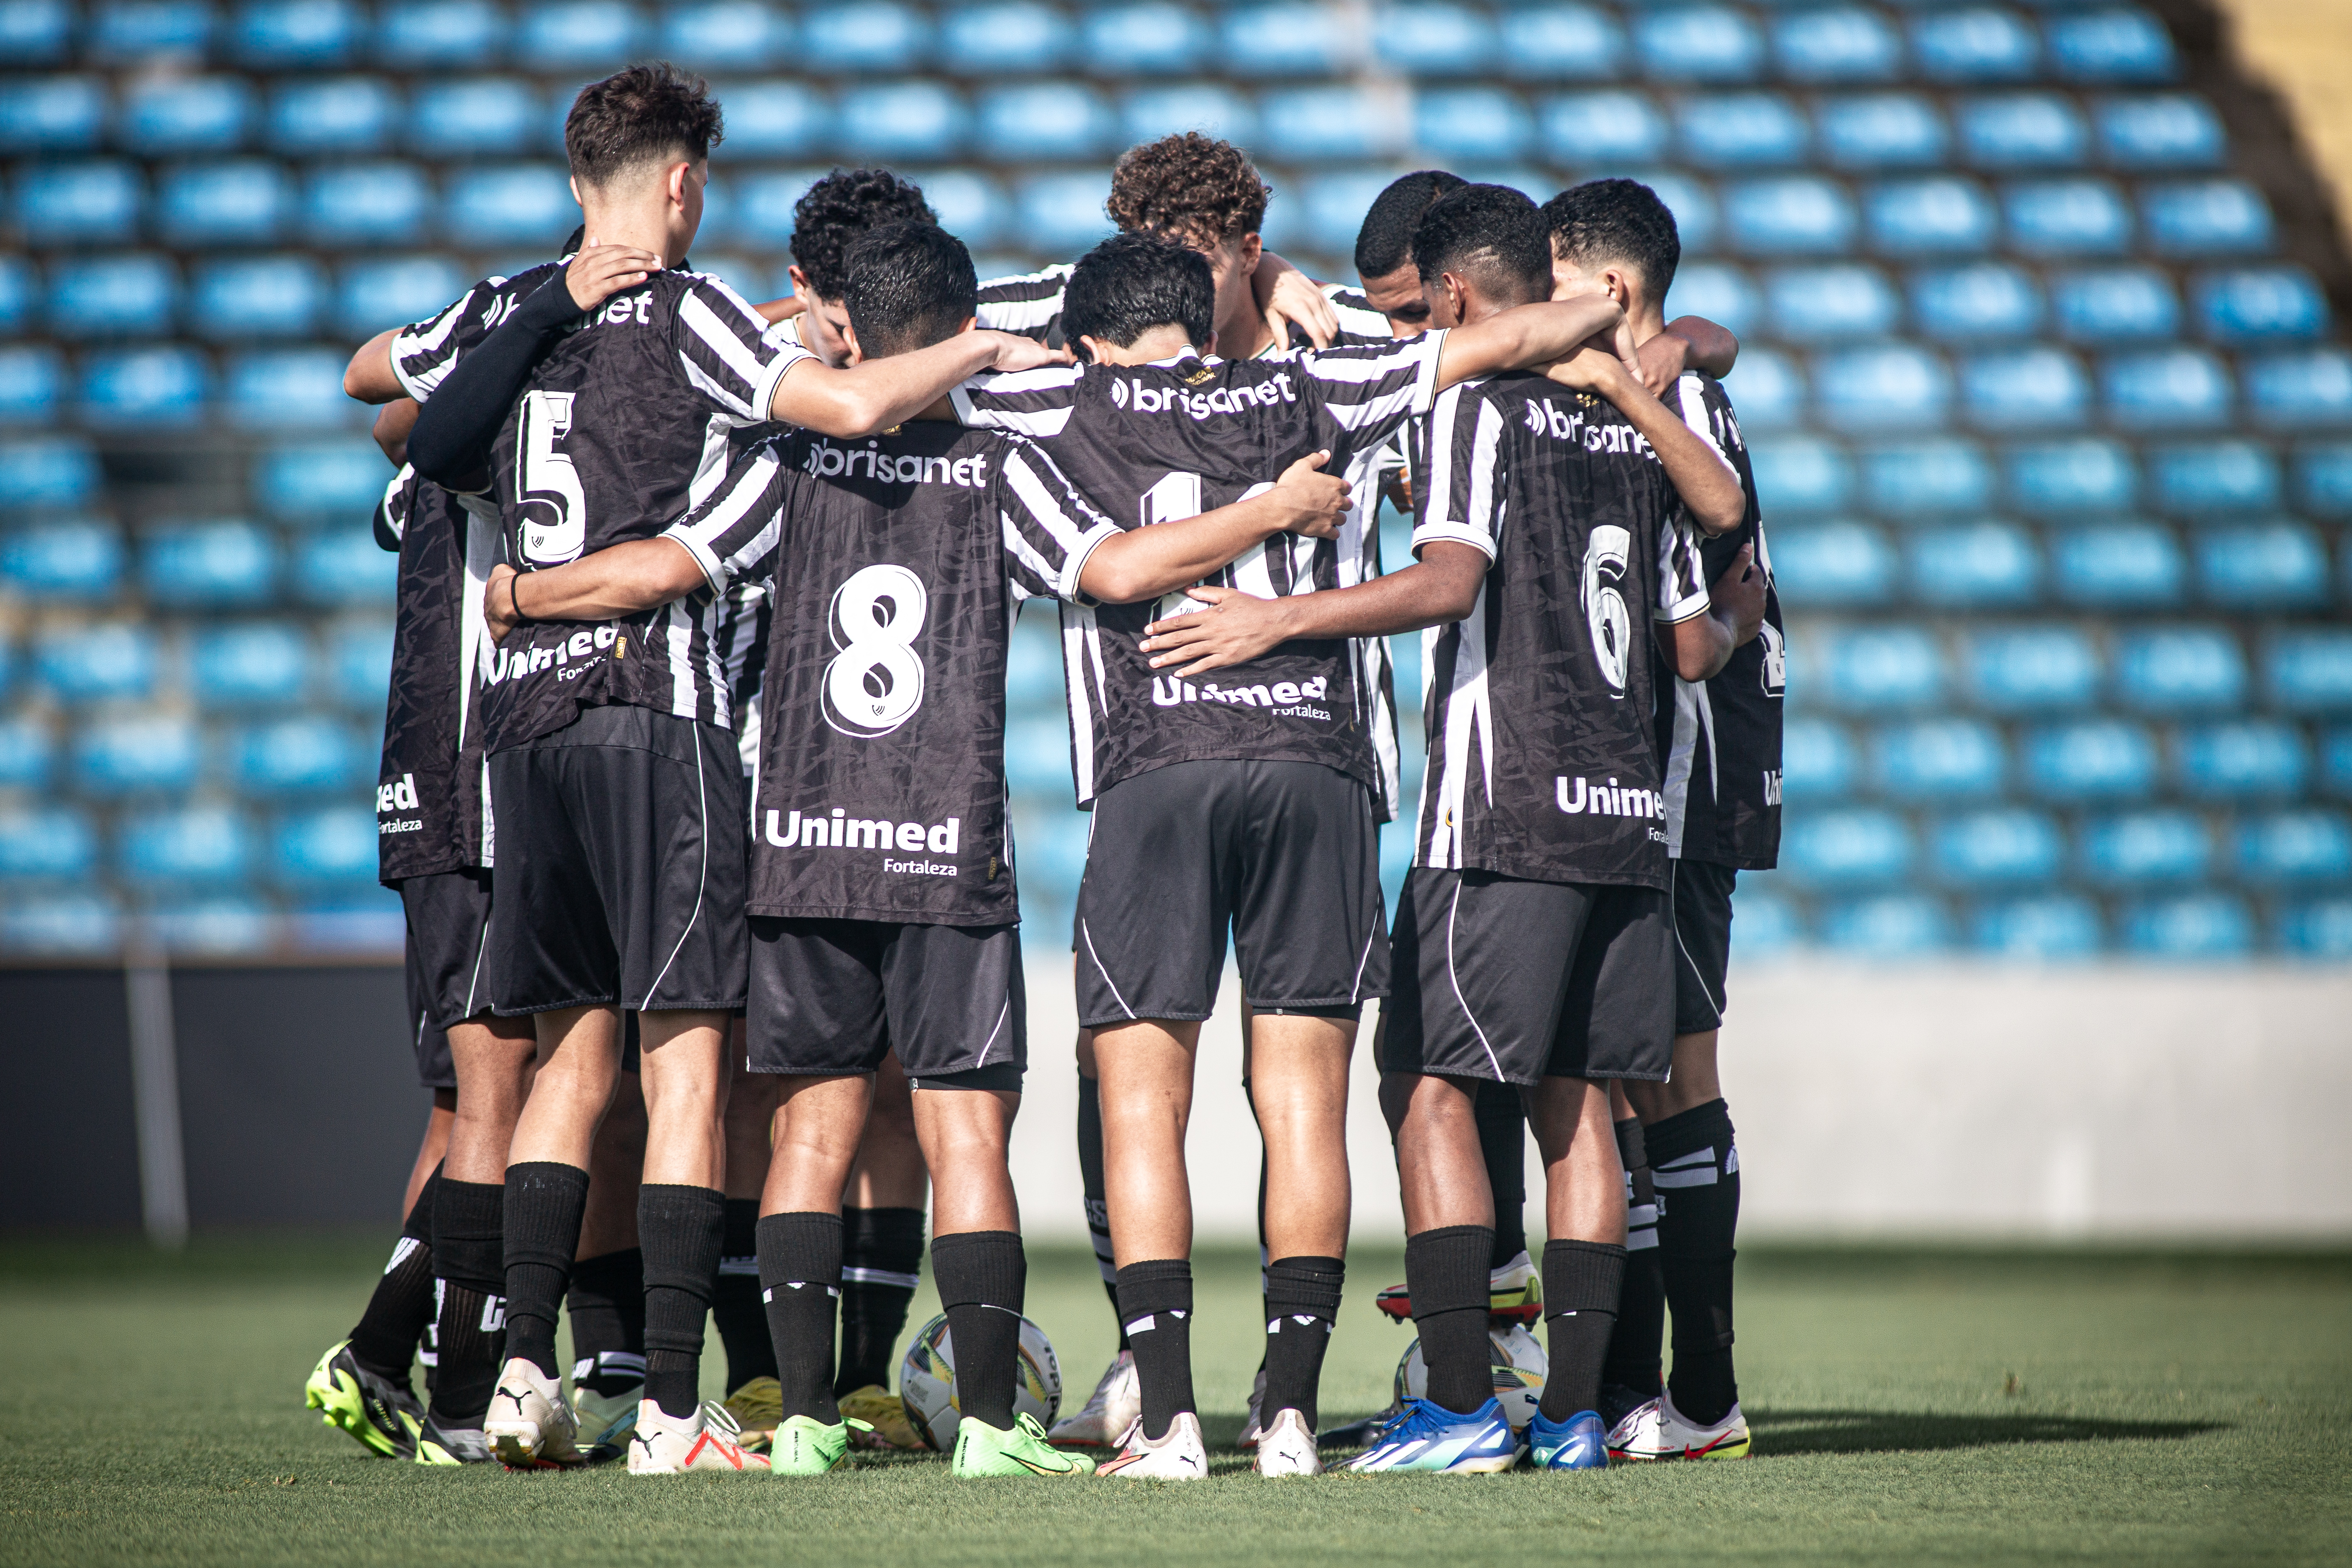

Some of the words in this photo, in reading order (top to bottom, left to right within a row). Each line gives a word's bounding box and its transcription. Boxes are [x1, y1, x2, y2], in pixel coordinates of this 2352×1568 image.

[1132, 372, 1296, 420] brisanet
[1543, 398, 1662, 464] brisane
[516, 390, 586, 572] 5
[821, 438, 987, 487] brisanet
[1580, 525, 1631, 699] 6
[821, 563, 927, 738] 8
[1555, 776, 1667, 821] Unime
[765, 808, 960, 854] Unimed
[884, 858, 957, 876] Fortaleza
